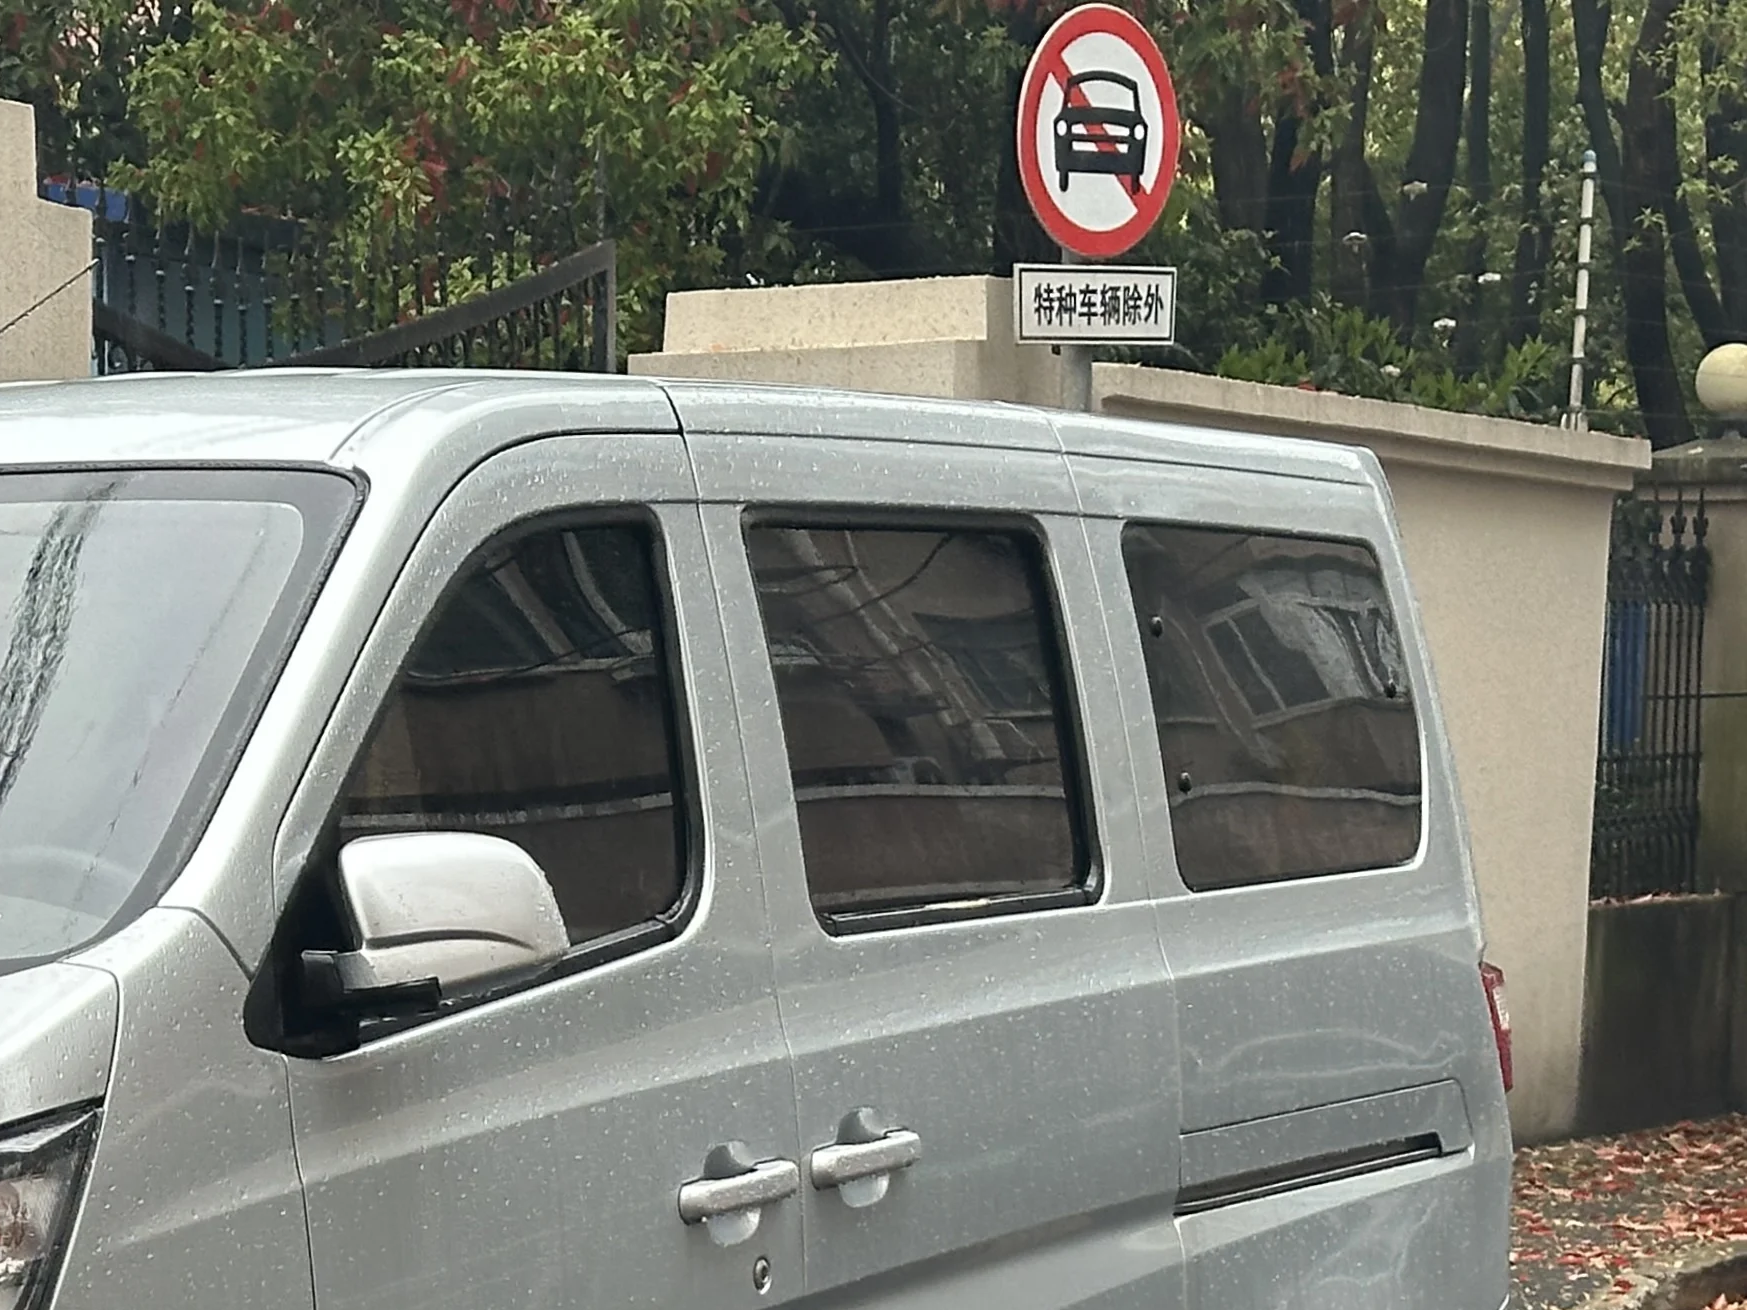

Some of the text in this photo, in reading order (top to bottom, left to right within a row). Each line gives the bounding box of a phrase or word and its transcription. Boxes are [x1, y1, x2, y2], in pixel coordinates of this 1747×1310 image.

[1033, 282, 1164, 327] 特种车辆除外
